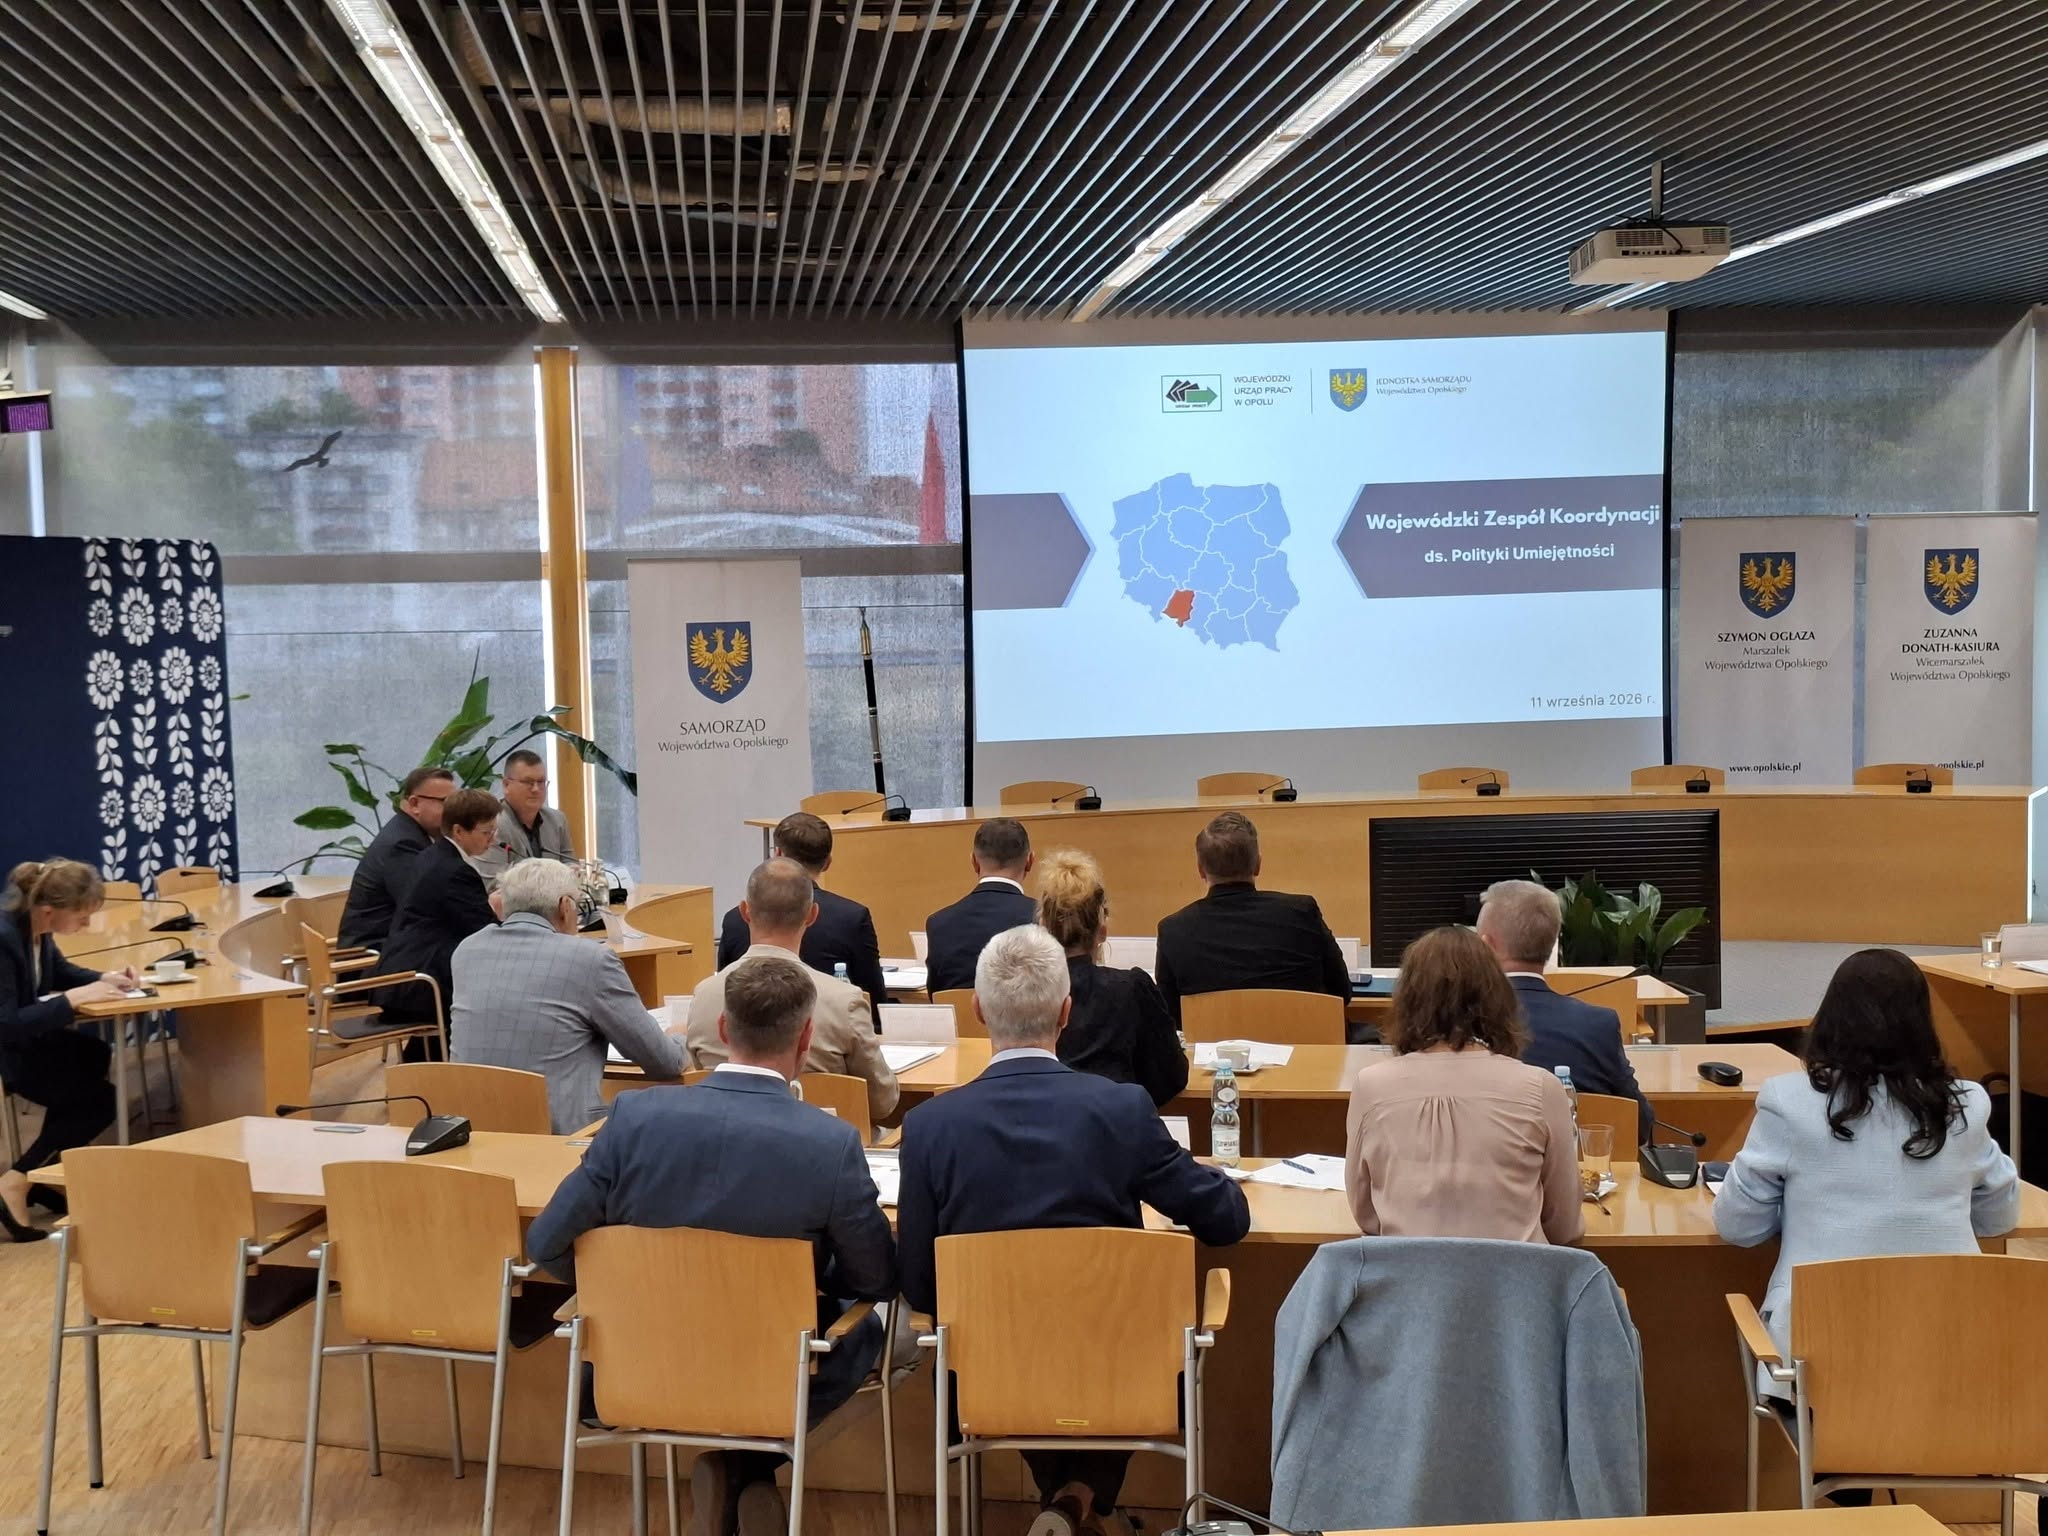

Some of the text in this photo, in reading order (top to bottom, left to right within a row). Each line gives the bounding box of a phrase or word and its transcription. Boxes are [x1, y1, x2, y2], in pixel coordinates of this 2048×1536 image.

[1376, 375, 1472, 386] JEDNOSTKA SAMORZĄDU
[1234, 386, 1293, 396] URZĄD PRACY
[1244, 398, 1274, 406] OPOLU
[1366, 504, 1661, 534] Wojewódzki Zespół Koordynacji
[1424, 543, 1615, 565] ds. Polityki Umiejętności
[1717, 631, 1766, 643] SZYMON
[1923, 628, 1978, 639] ZUZANNA
[1902, 641, 2000, 653] DONATH-KASIURA
[1704, 658, 1828, 672] Województwa Opolskiego
[1890, 669, 2011, 683] Województwa Opolskiego
[1530, 693, 1656, 708] 11 września 2026 r.
[680, 718, 766, 736] SAMORZĄD
[658, 736, 789, 754] Województwa Opolskiego
[1728, 761, 1802, 774] www.opolskie.pl
